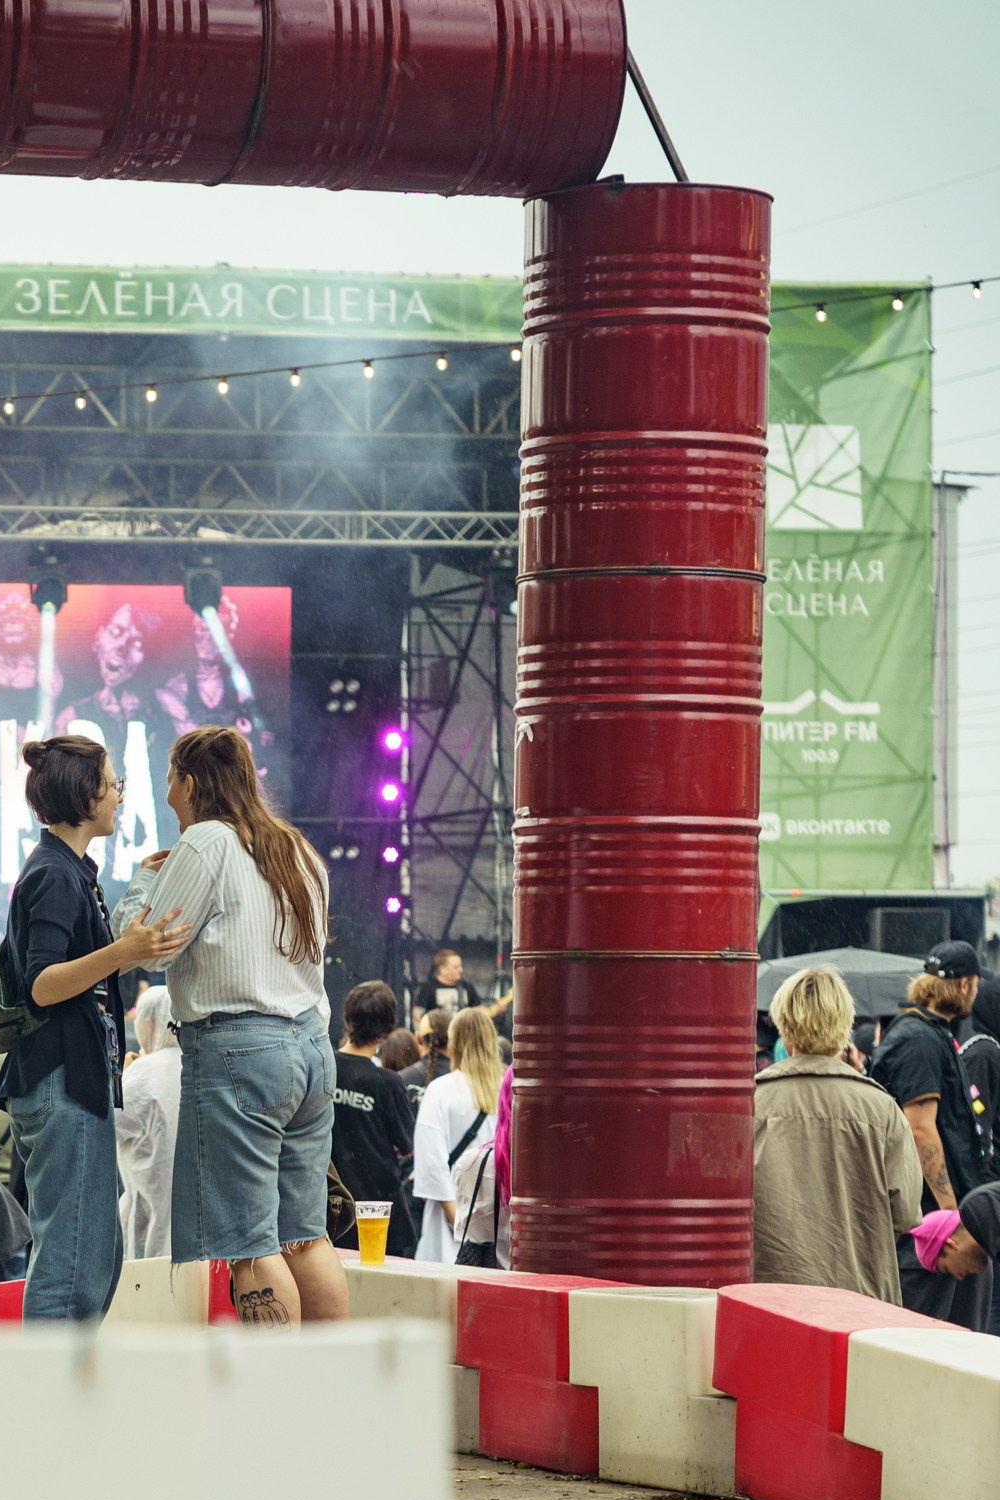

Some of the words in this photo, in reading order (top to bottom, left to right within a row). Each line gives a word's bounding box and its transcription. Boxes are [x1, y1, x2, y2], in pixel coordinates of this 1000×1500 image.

[14, 271, 244, 318] ЗЕЛЁНАЯ
[265, 283, 434, 325] СЦЕНА
[767, 552, 884, 582] ЕЛЁНАЯ
[764, 591, 870, 618] СЦЕНА
[763, 721, 838, 742] ПИТЕР
[844, 721, 878, 742] FM
